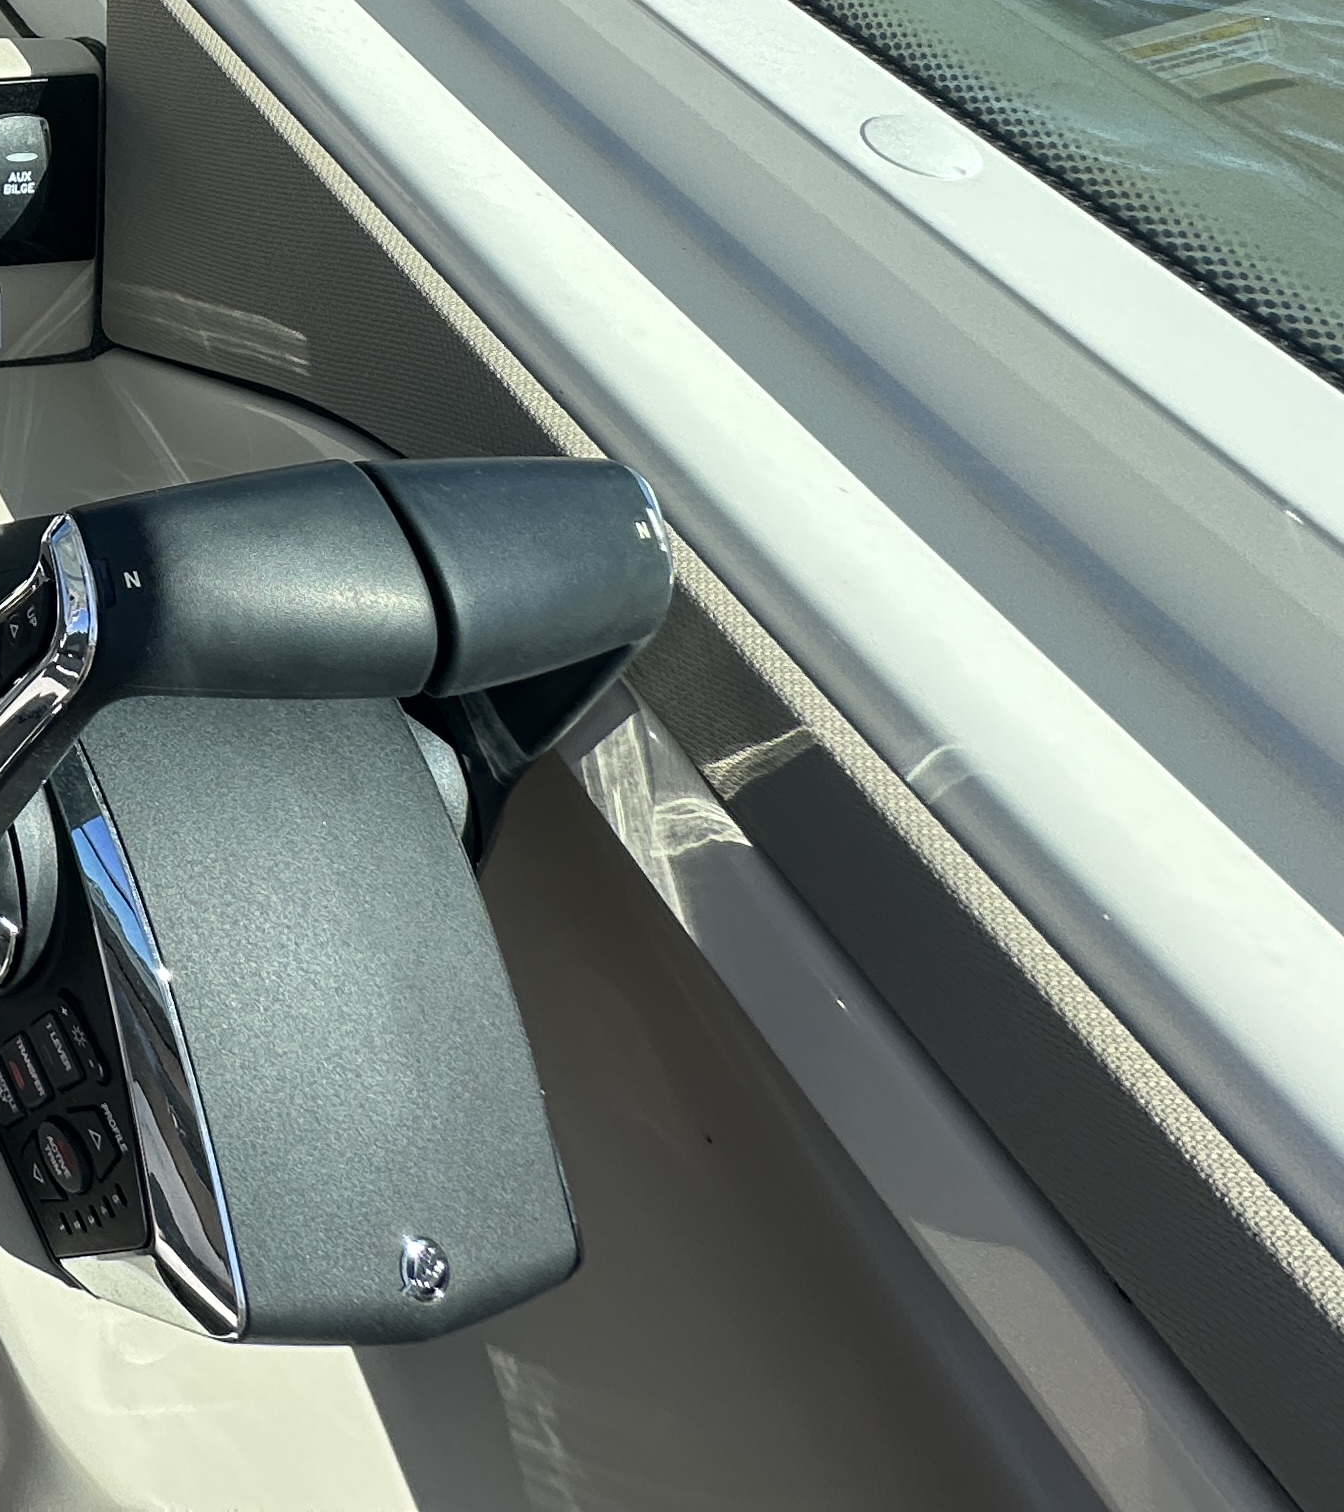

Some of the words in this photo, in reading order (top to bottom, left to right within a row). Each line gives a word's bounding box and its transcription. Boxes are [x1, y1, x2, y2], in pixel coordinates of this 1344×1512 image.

[3, 182, 36, 196] BILGE
[8, 171, 32, 183] AUX
[635, 521, 651, 539] N
[123, 571, 141, 588] N
[26, 604, 38, 627] UP
[15, 1033, 45, 1097] TRANSFER
[50, 1031, 72, 1072] LEVER
[100, 1102, 128, 1154] PROFILE
[44, 1143, 63, 1176] TRIM
[46, 1135, 72, 1179] ACTIVE
